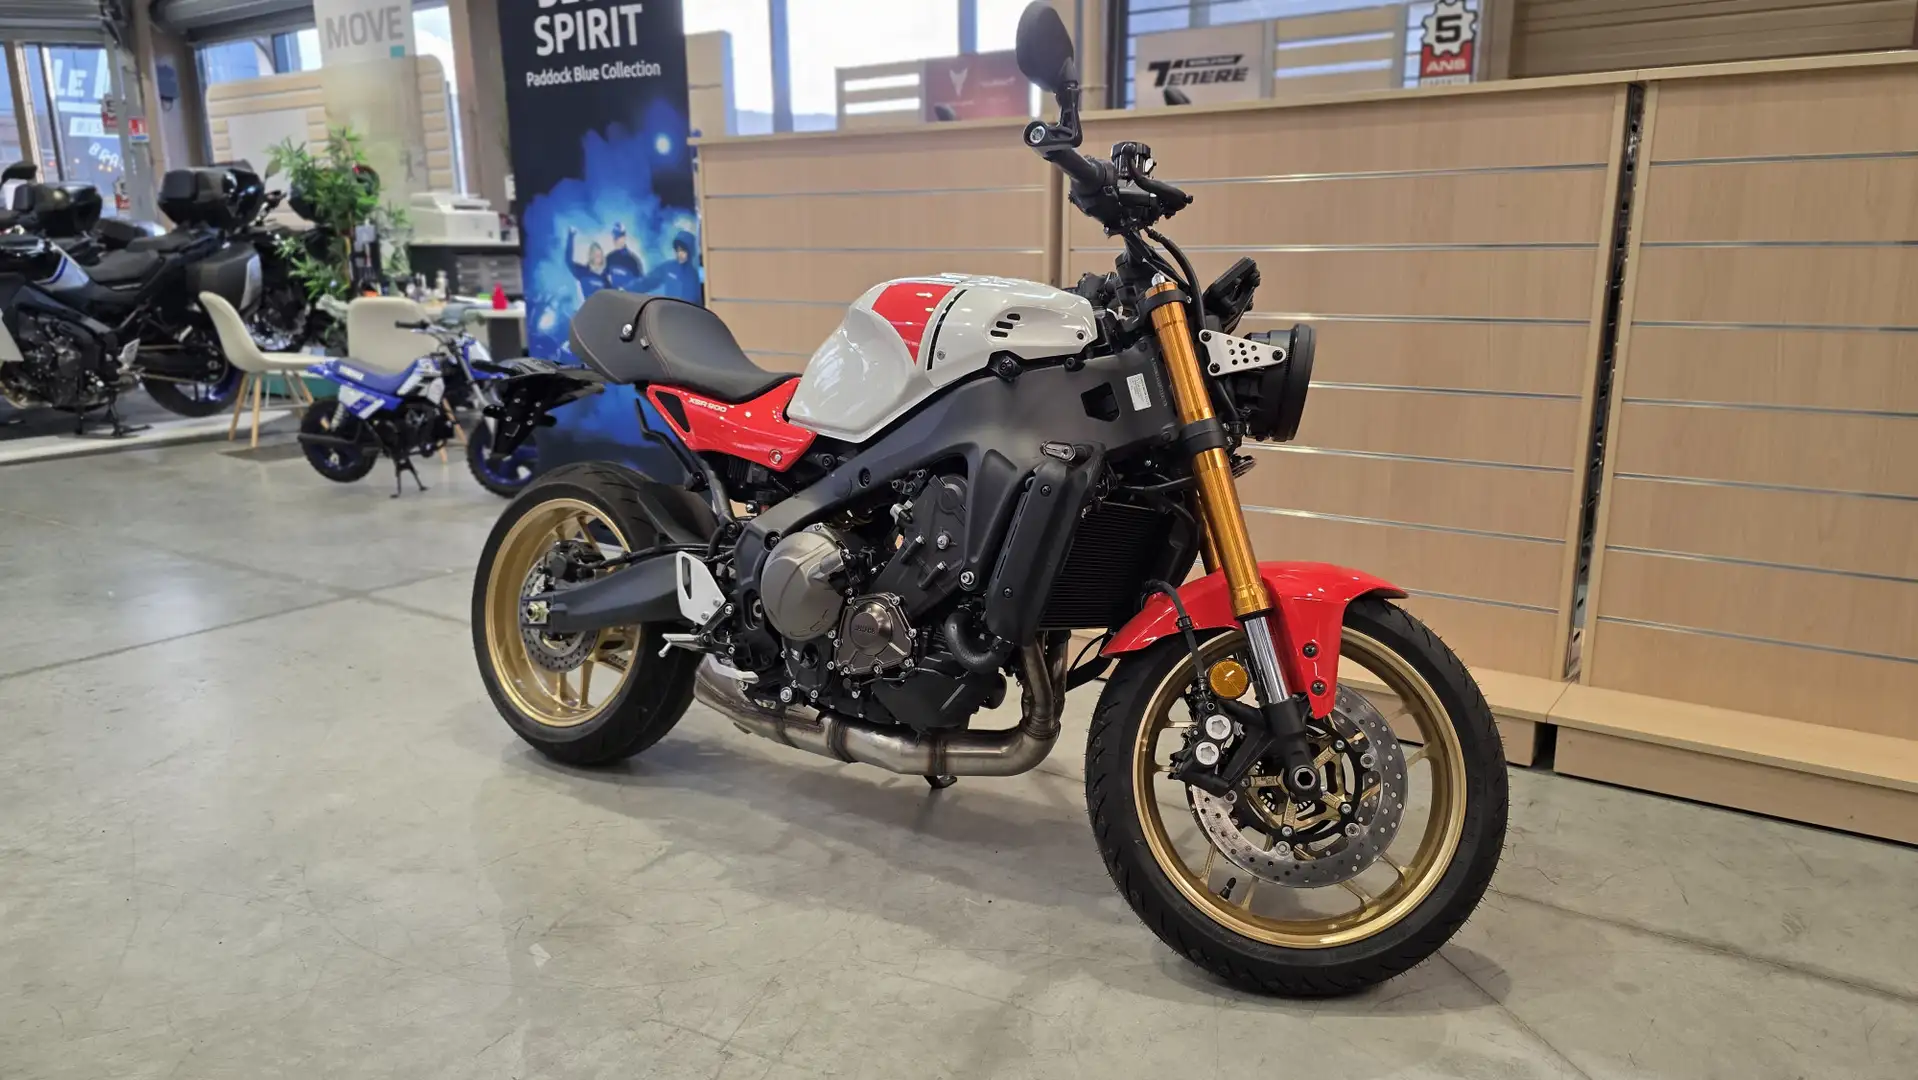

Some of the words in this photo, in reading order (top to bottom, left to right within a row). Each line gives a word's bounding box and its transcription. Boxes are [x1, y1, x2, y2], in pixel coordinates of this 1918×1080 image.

[325, 6, 404, 50] MOVE
[534, 4, 643, 56] SPIRIT
[1435, 14, 1462, 43] 5
[526, 67, 573, 87] Paddock
[573, 65, 600, 82] Blue
[601, 60, 661, 80] Collection
[1426, 58, 1468, 74] ANS
